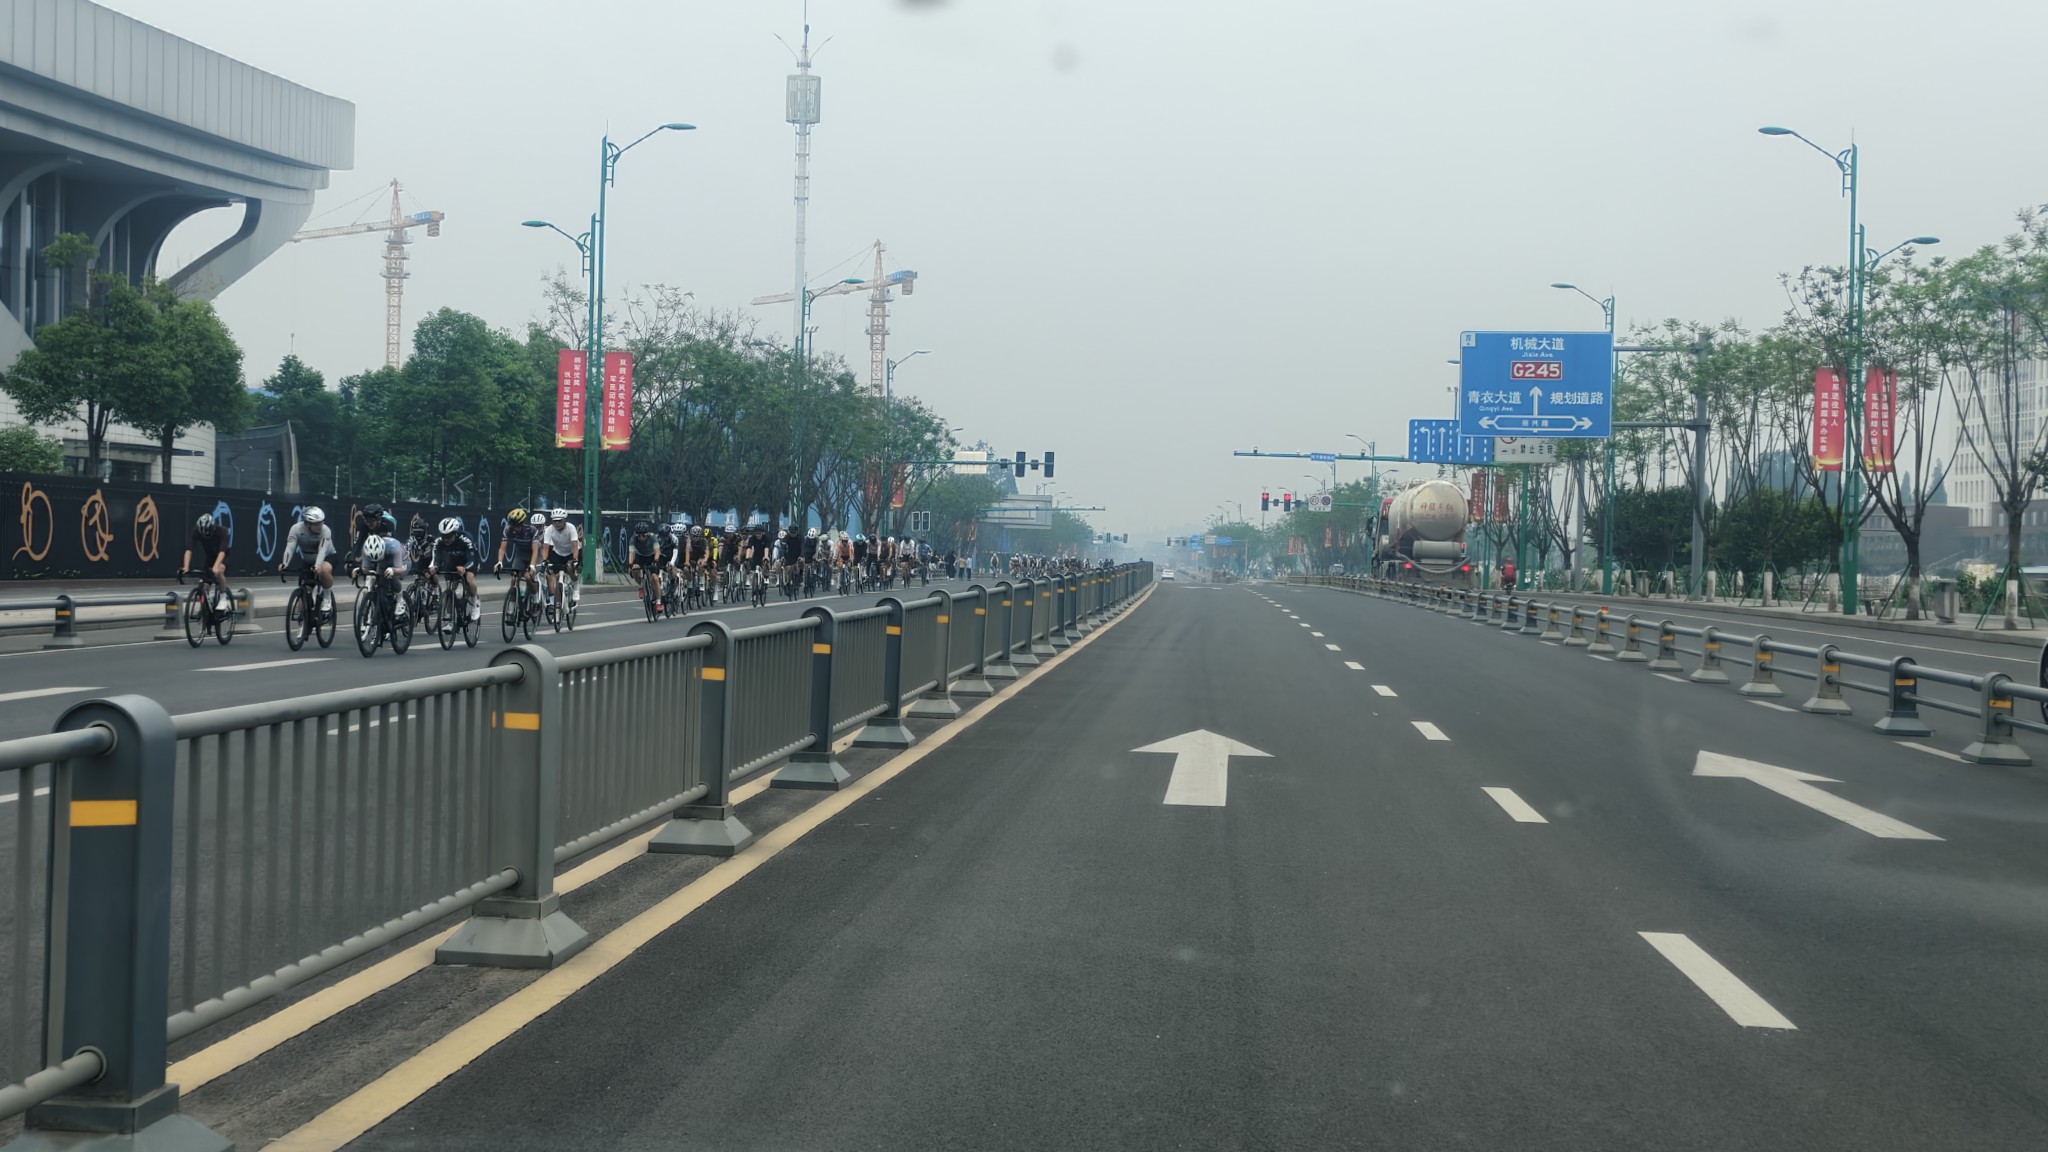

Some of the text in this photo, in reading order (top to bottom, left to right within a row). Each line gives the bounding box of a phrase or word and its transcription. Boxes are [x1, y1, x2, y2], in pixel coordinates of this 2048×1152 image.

[1511, 337, 1565, 351] 机械大道
[1513, 363, 1560, 377] G245
[1468, 390, 1522, 404] 青衣大道
[1550, 391, 1604, 405] 规划道路
[1831, 374, 1840, 427] 情系退役军人
